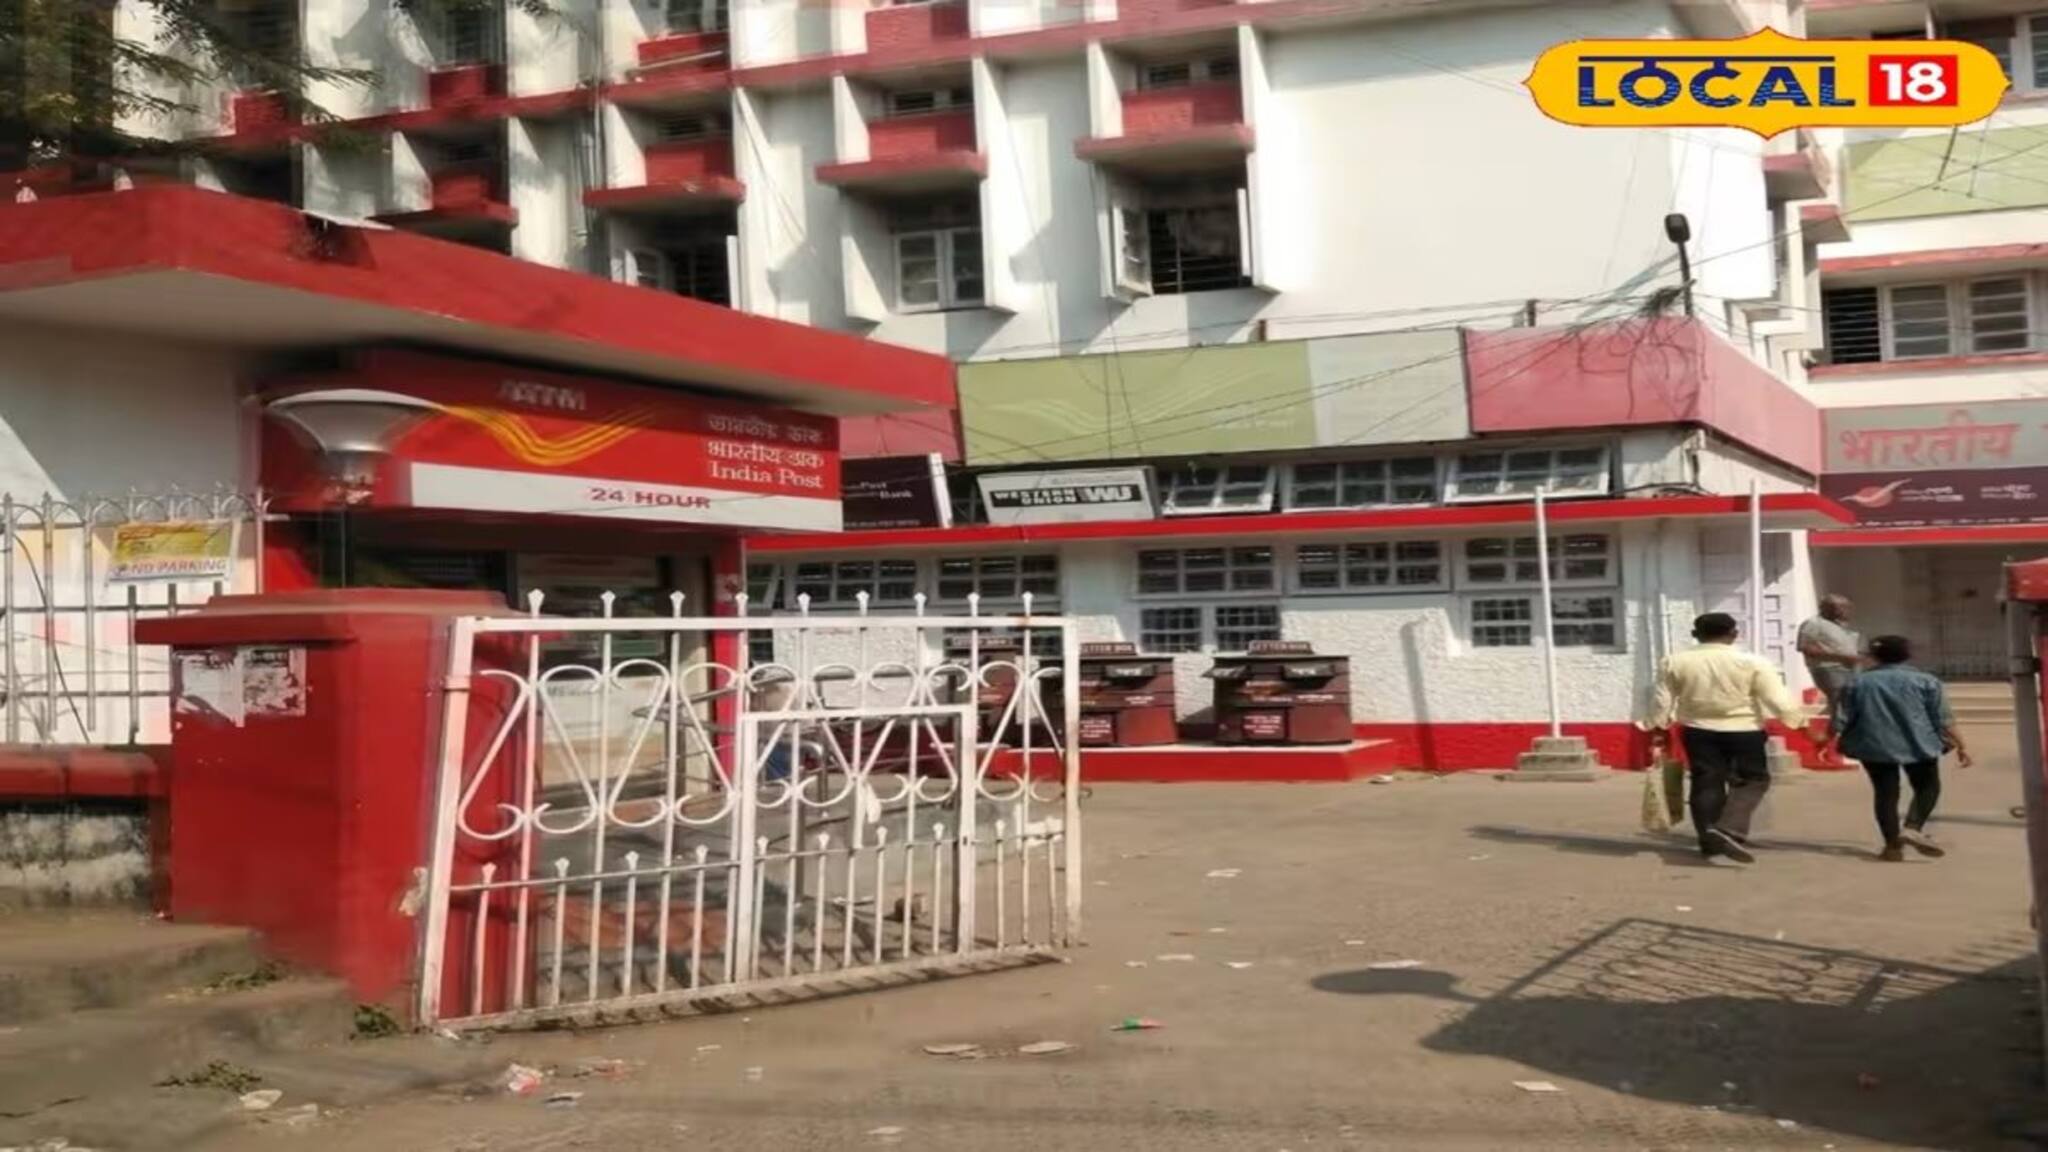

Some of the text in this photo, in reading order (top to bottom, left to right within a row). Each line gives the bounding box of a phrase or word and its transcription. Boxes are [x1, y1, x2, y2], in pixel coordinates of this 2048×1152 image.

[1840, 409, 2021, 465] भारतीय
[707, 440, 824, 468] भारतीय डाक
[709, 460, 823, 489] India Post
[591, 487, 711, 509] 24 HOUR
[994, 486, 1133, 502] WESTERN WU
[1021, 495, 1077, 505] UNION
[157, 559, 226, 572] PARKING
